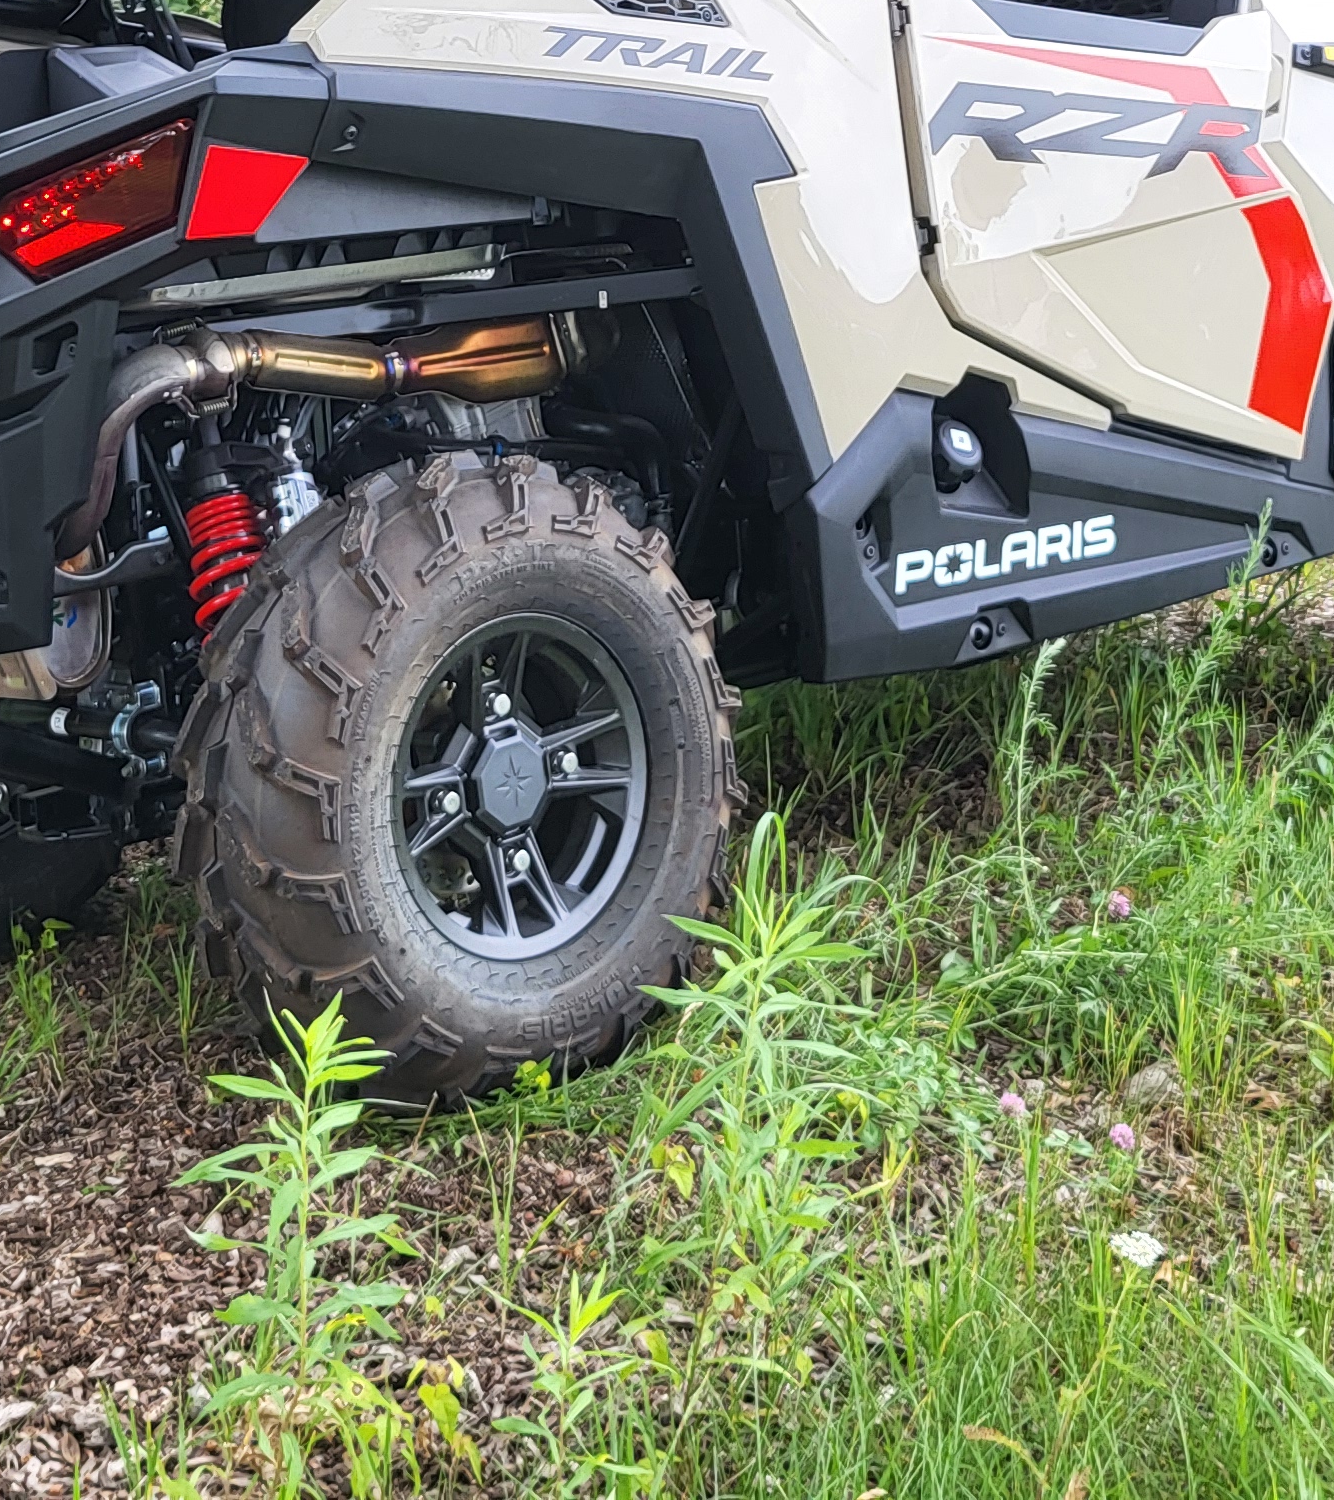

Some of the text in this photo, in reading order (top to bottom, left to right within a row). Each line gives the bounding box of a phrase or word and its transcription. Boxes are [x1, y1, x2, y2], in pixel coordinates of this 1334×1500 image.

[543, 26, 773, 81] TRAIL
[927, 81, 1269, 180] RZR
[894, 514, 1118, 596] POLARIS
